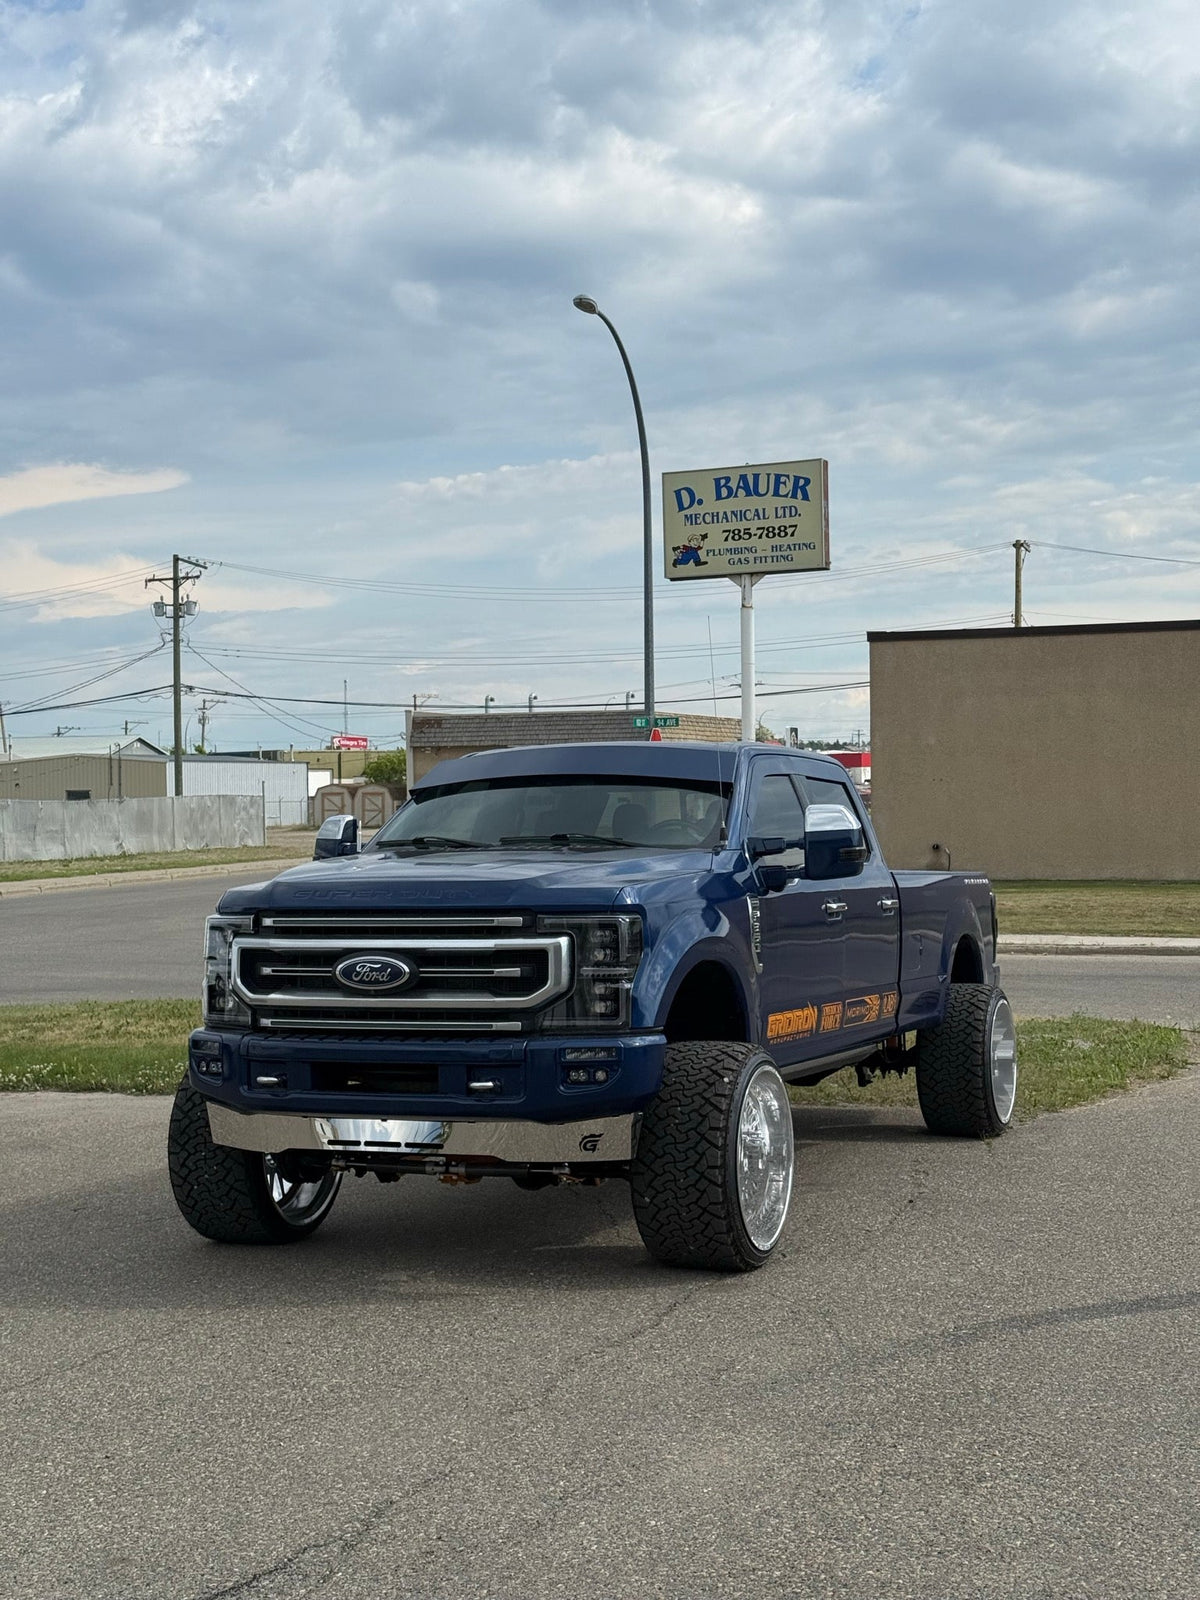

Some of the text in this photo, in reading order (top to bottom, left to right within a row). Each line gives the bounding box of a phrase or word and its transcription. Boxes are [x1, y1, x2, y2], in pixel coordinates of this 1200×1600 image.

[673, 472, 812, 513] D. BAUER
[684, 505, 802, 526] MECHANICAL LTD.
[722, 524, 798, 542] 785-7887
[706, 545, 758, 557] PLUMBING
[771, 542, 816, 553] HEATING
[728, 554, 794, 566] GAS FITTING
[293, 889, 393, 899] SUPER
[352, 962, 392, 982] Ford
